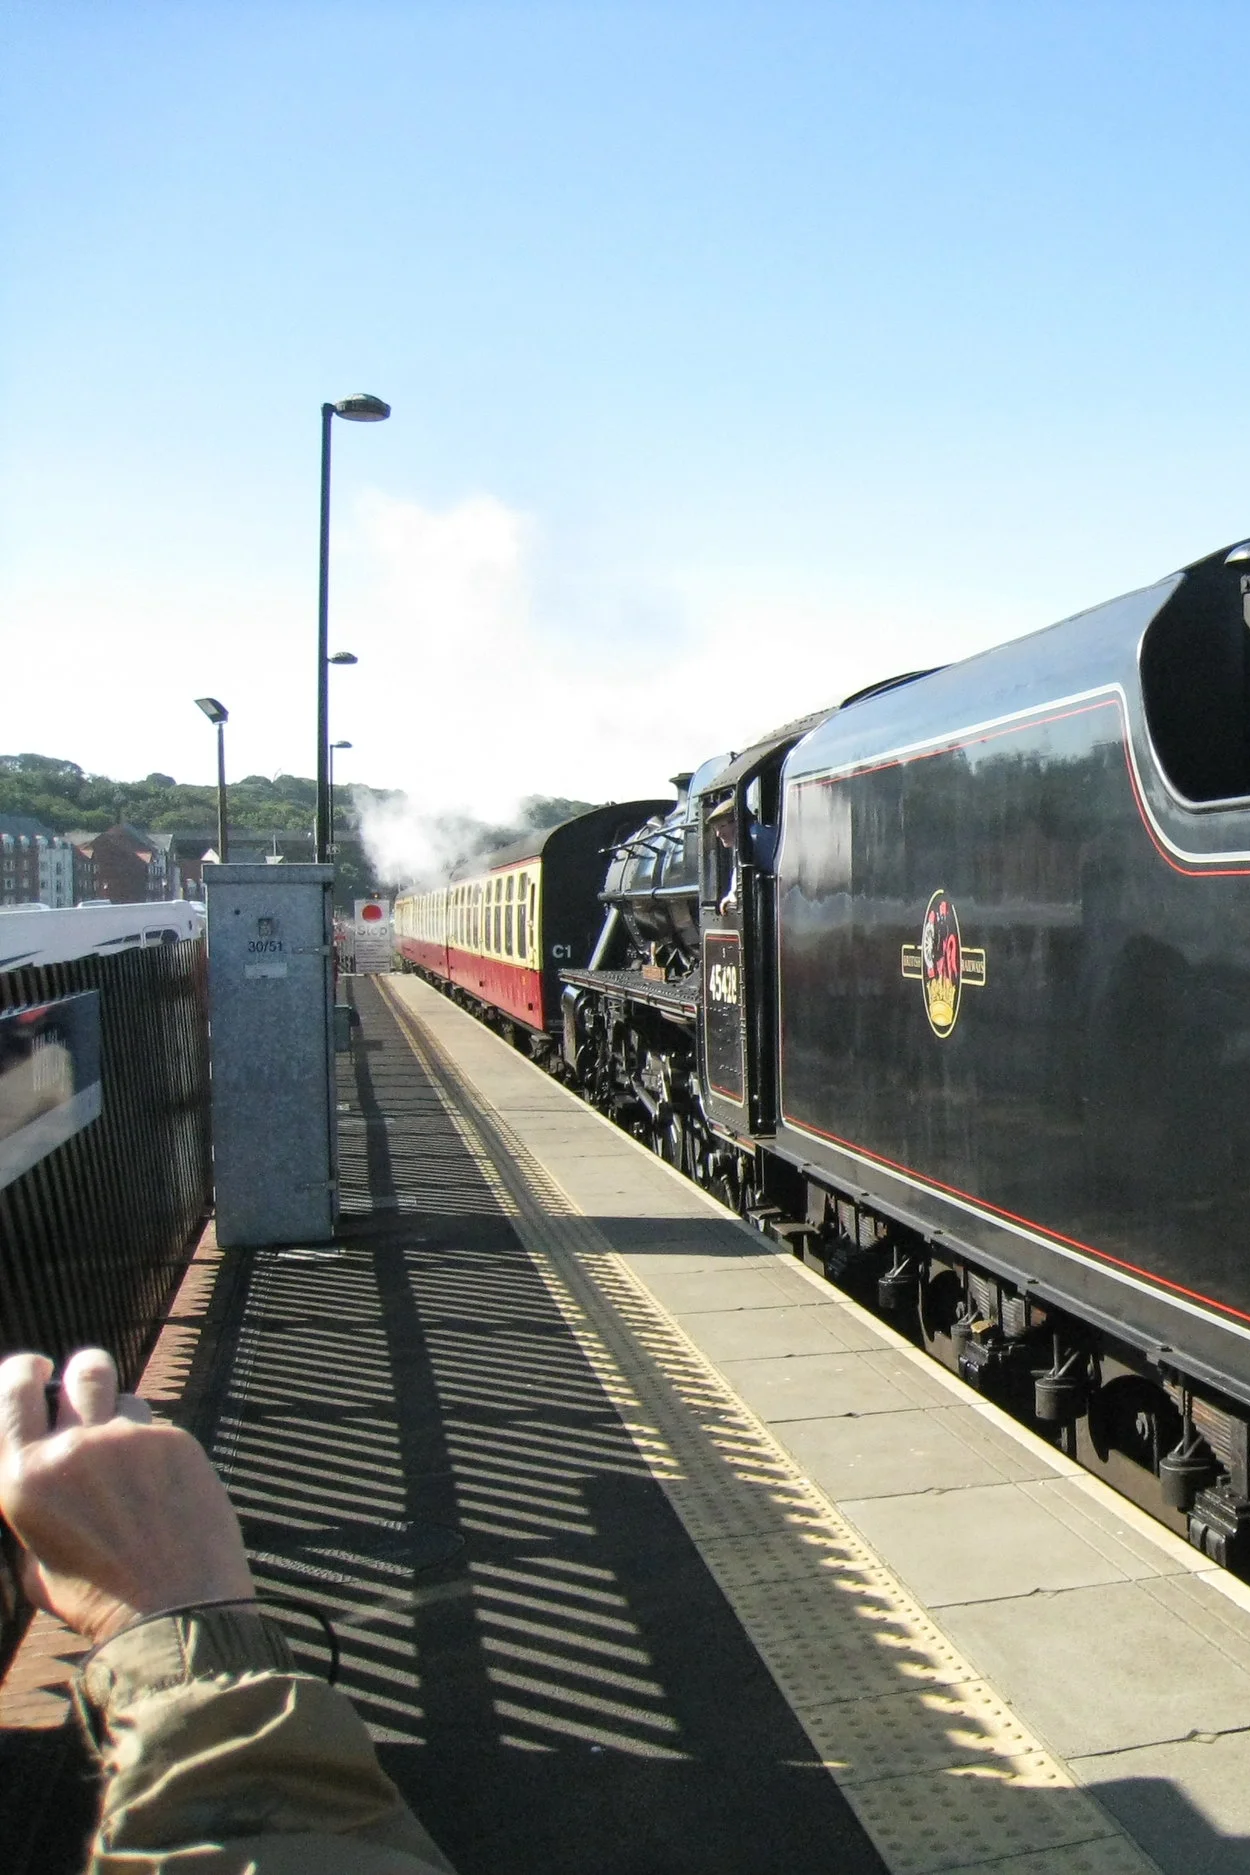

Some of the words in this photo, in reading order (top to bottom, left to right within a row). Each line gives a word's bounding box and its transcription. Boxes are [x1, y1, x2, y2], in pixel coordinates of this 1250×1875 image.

[357, 925, 388, 937] Stop
[247, 940, 283, 953] 30/51
[552, 944, 571, 959] C1
[710, 964, 737, 1004] 45428
